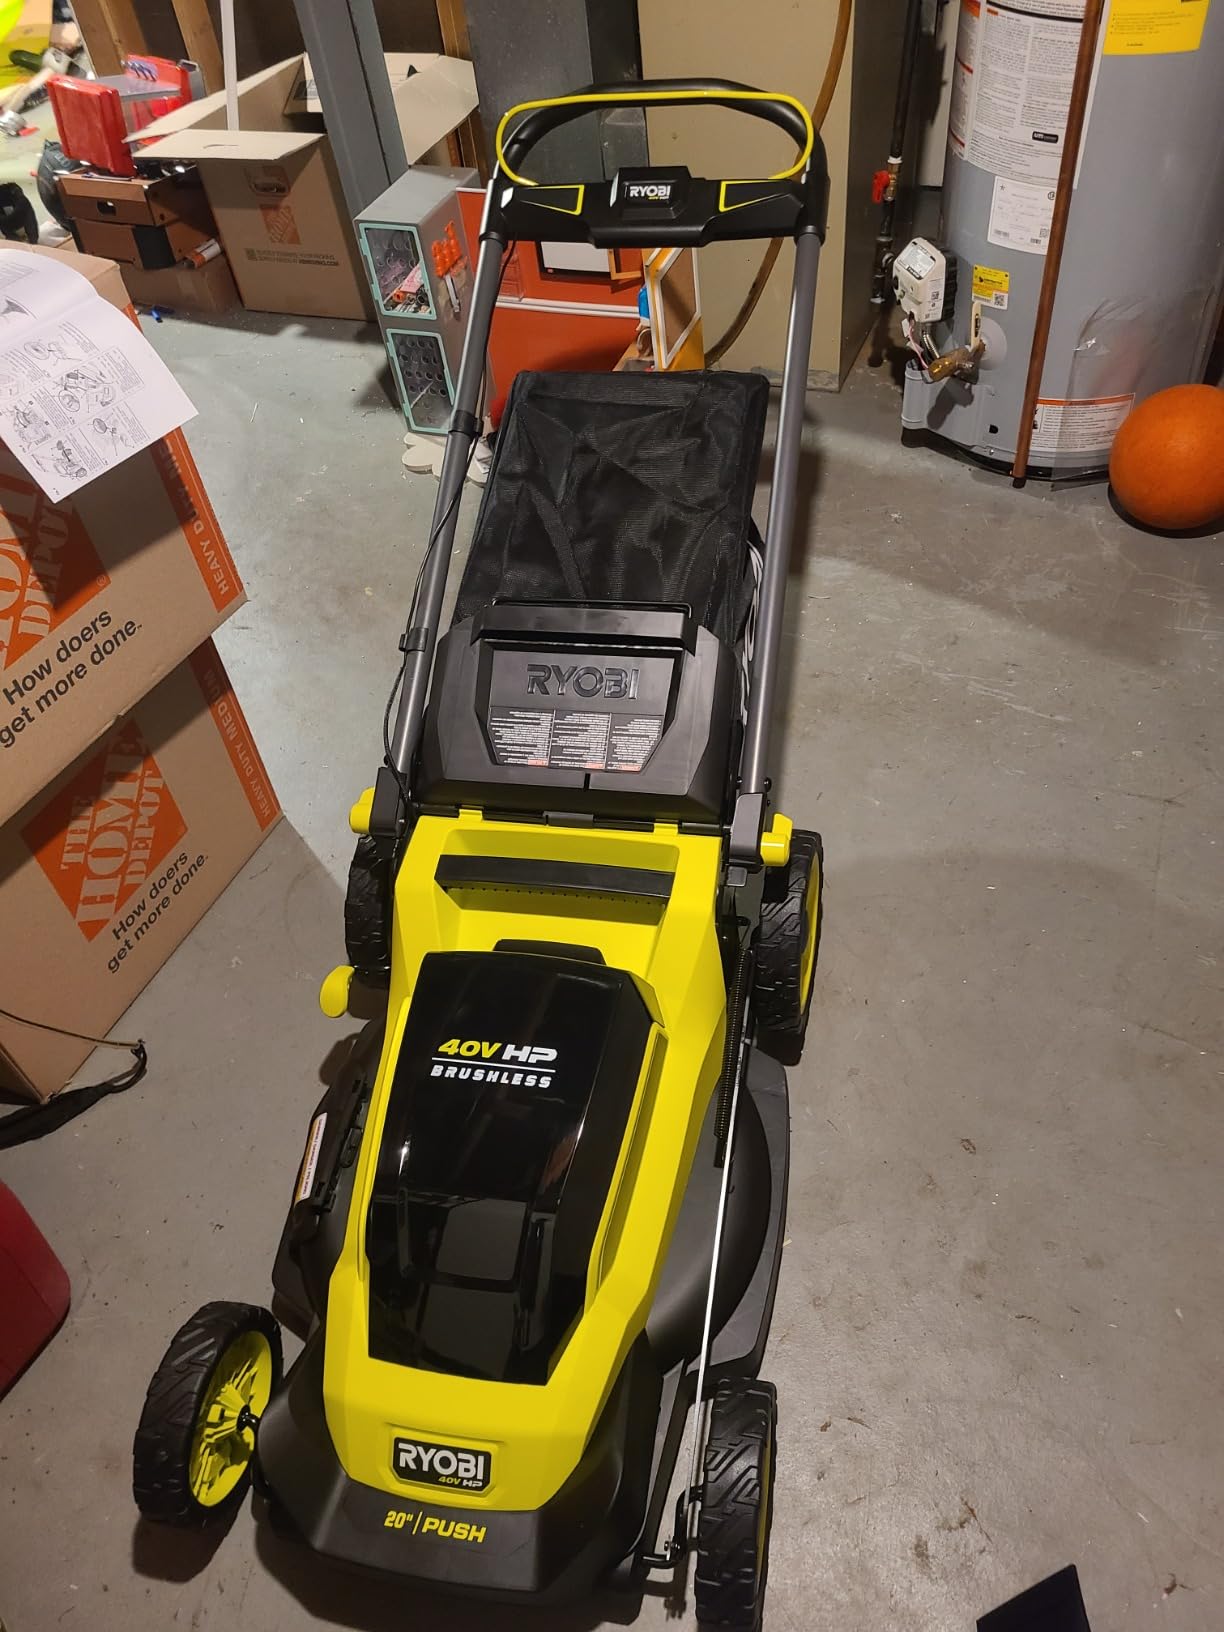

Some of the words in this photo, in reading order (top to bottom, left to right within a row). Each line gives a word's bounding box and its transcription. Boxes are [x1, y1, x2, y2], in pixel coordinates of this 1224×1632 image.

[629, 185, 671, 197] RYOBI
[177, 486, 205, 535] DUTY
[199, 537, 230, 596] HEAVY
[2, 659, 53, 706] How
[55, 609, 113, 663] doers
[527, 664, 640, 699] RYOBI
[0, 705, 37, 749] get
[35, 662, 88, 714] more
[233, 743, 255, 778] DUTY
[249, 781, 271, 818] HEAVY
[59, 796, 95, 870] THE
[74, 735, 147, 925] HOME
[124, 769, 166, 886] DEPOT
[112, 900, 147, 940] How
[149, 851, 188, 900] doers
[107, 938, 134, 974] get
[135, 895, 170, 943] more
[438, 1039, 502, 1058] 40V
[502, 1044, 558, 1064] HP
[430, 1064, 552, 1089] BRUSHLESS
[398, 1442, 485, 1480] RYOBI
[438, 1476, 461, 1485] 40V
[384, 1510, 414, 1529] 20"
[421, 1517, 487, 1543] PUSH
